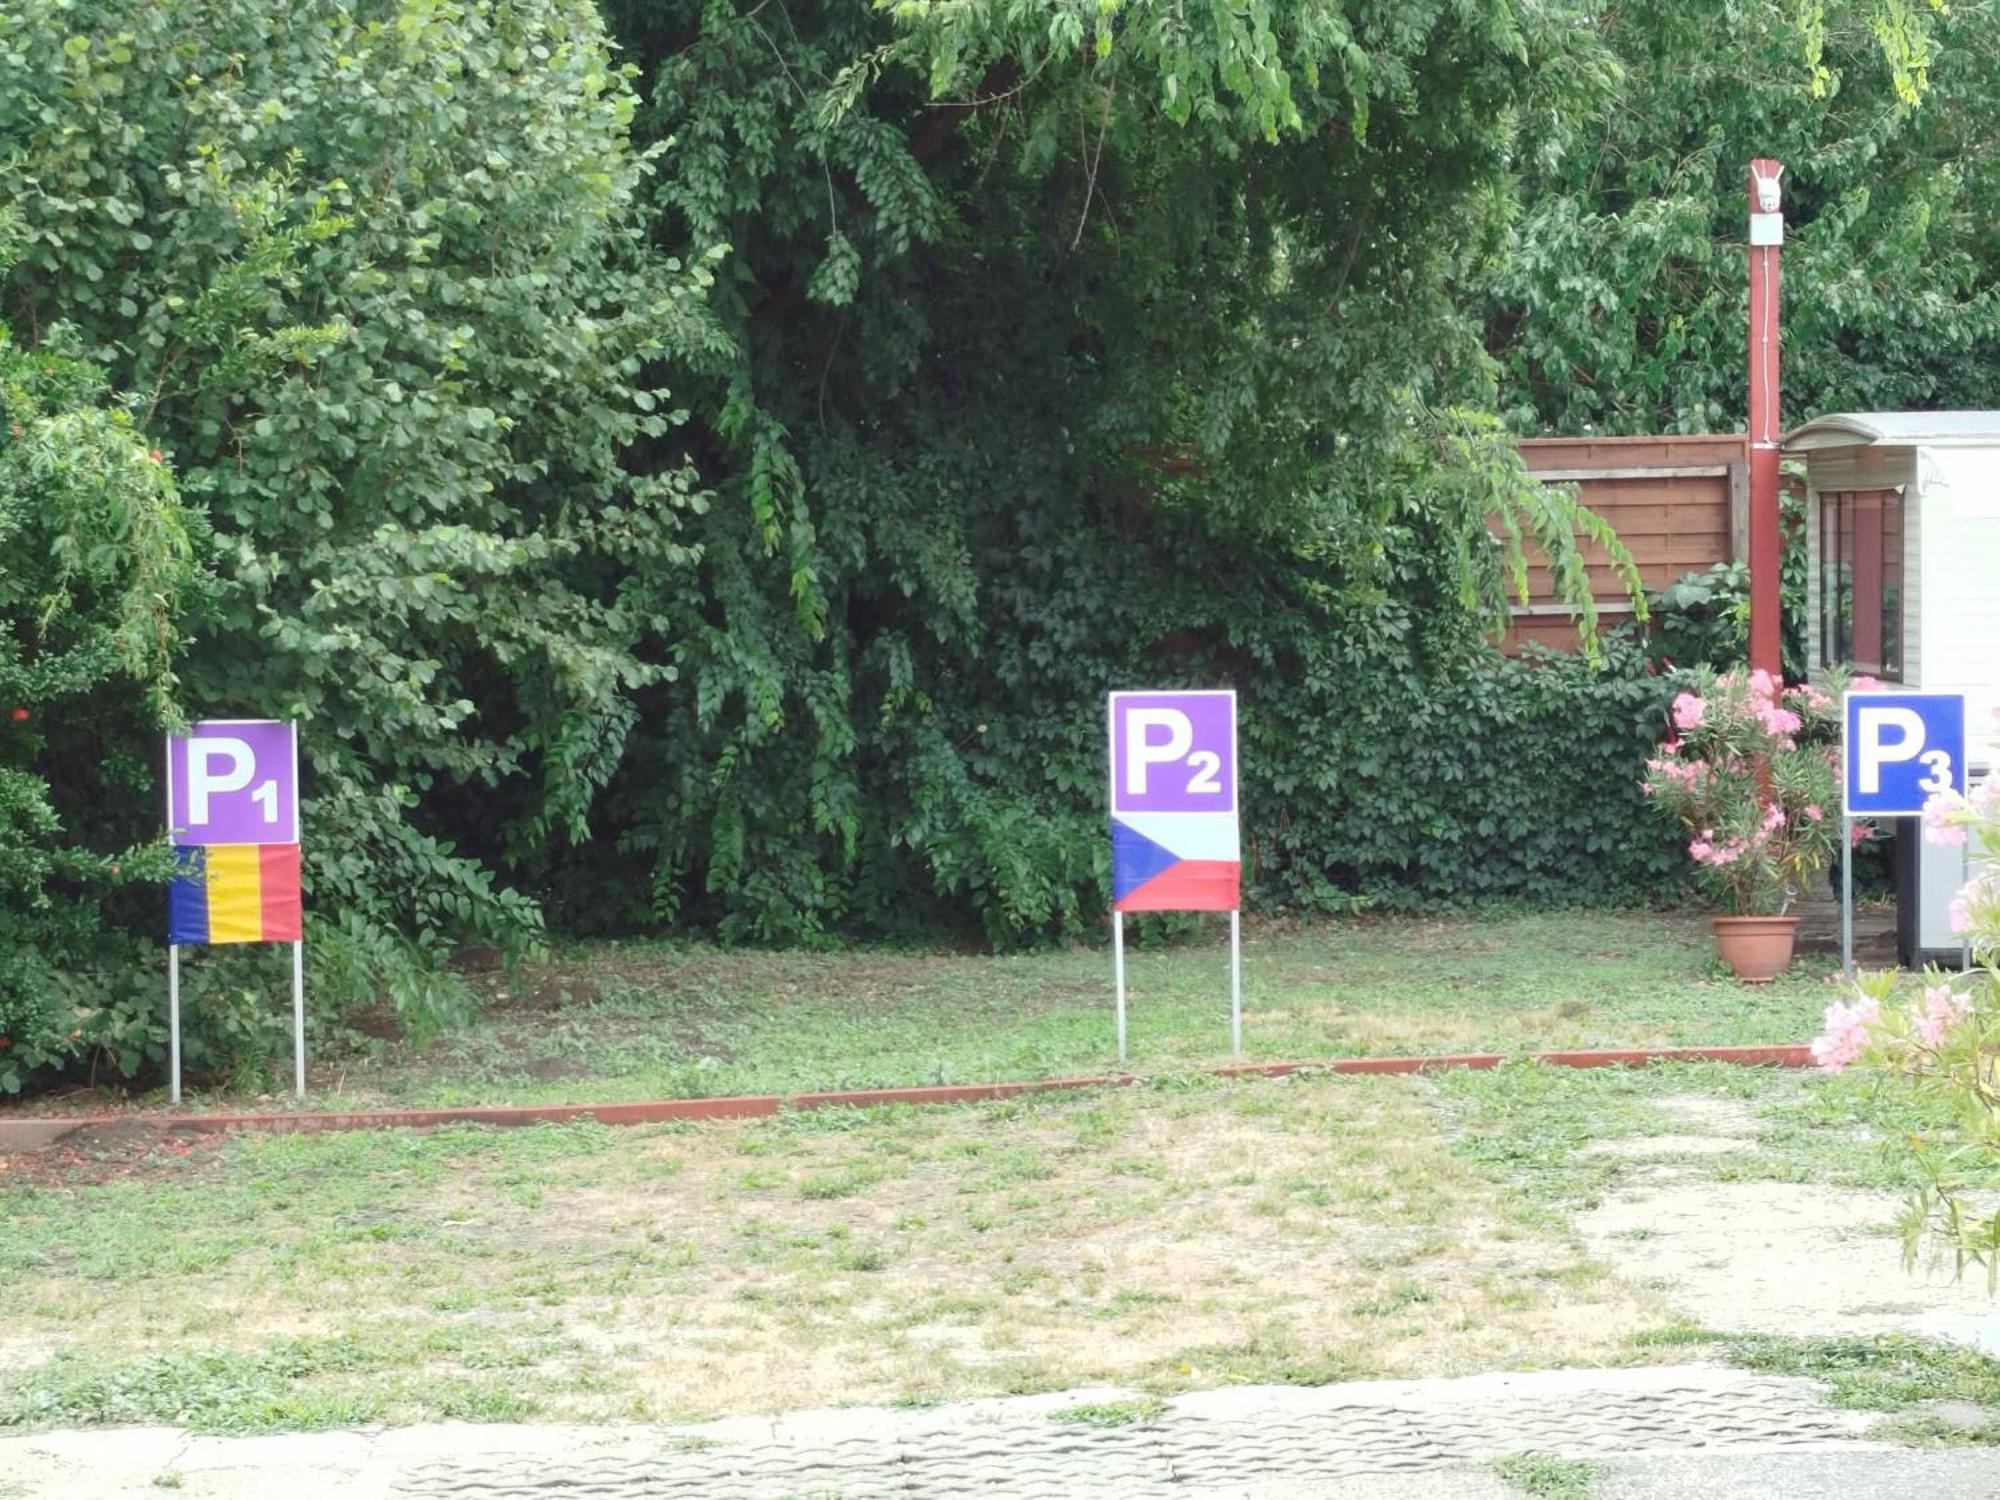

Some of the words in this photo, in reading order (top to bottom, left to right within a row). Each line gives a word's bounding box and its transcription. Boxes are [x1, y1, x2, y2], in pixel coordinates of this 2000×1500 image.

[187, 737, 278, 824] P1
[1126, 708, 1222, 794] P2
[1859, 707, 1952, 793] P3
